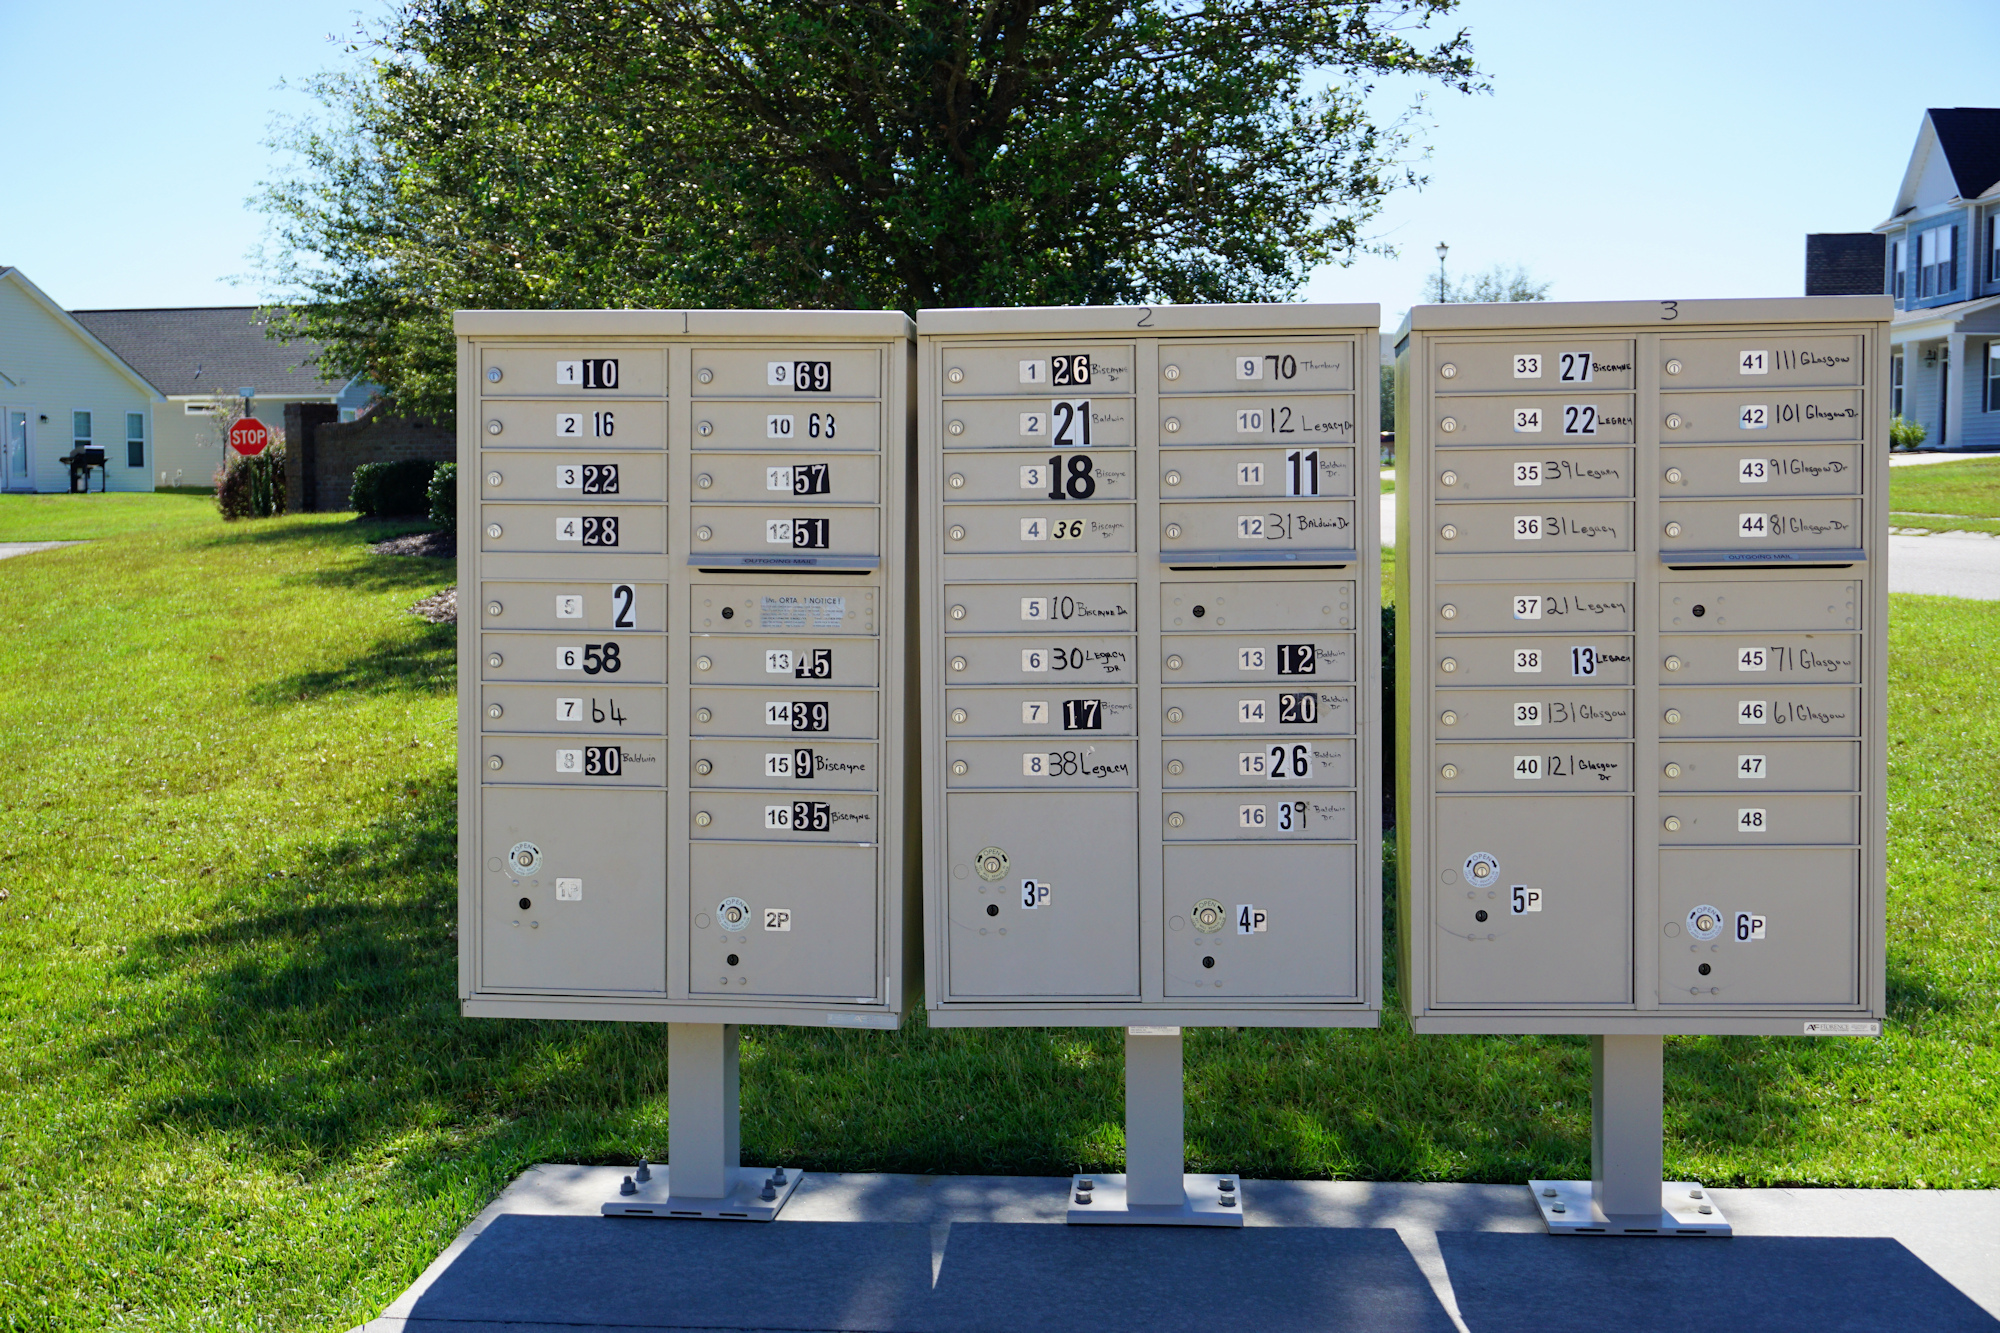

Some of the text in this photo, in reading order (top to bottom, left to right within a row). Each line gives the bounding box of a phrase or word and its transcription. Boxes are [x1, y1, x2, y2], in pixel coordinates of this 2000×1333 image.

[1137, 308, 1154, 327] 2
[1661, 301, 1678, 320] 3
[1244, 361, 1255, 376] 9
[1265, 354, 1297, 380] 70
[1517, 359, 1538, 372] 33
[1561, 354, 1590, 380] 27
[1742, 355, 1763, 369] 41
[1776, 350, 1796, 370] 111
[566, 365, 574, 380] 1
[585, 360, 617, 387] 10
[776, 366, 786, 381] 9
[796, 362, 829, 390] 69
[1028, 364, 1035, 379] 1
[1053, 356, 1088, 384] 26
[1240, 413, 1261, 429] 10
[1271, 407, 1294, 432] 12
[1517, 413, 1538, 426] 34
[1565, 407, 1595, 433] 22
[1742, 409, 1764, 423] 42
[1777, 404, 1800, 423] 101
[1806, 405, 1845, 420] Glasgow
[565, 418, 575, 433] 2
[594, 411, 614, 437] 16
[770, 419, 790, 434] 10
[808, 413, 836, 438] 63
[1028, 417, 1038, 431] 2
[1053, 402, 1090, 445] 21
[232, 430, 265, 445] STOP
[1241, 466, 1259, 481] 11
[1288, 451, 1318, 495] 11
[1517, 466, 1538, 480] 35
[1545, 461, 1572, 479] 39
[1743, 463, 1764, 477] 43
[1770, 459, 1786, 475] 91
[1791, 459, 1831, 476] Glasgow
[565, 470, 575, 484] 3
[584, 465, 617, 493] 22
[795, 465, 826, 493] 57
[1028, 470, 1038, 484] 3
[1049, 455, 1095, 499] 18
[564, 521, 574, 537] 4
[584, 518, 617, 545] 28
[1028, 522, 1039, 537] 4
[1053, 520, 1083, 538] 36
[1241, 519, 1262, 535] 12
[1267, 513, 1292, 539] 31
[1517, 520, 1538, 534] 36
[1546, 517, 1616, 538] 31 Legacy
[1742, 517, 1764, 531] 44
[1770, 515, 1785, 535] 81
[795, 520, 825, 547] 51
[615, 585, 634, 627] 2
[1029, 602, 1039, 617] 5
[1051, 596, 1074, 619] 10
[1517, 600, 1537, 613] 37
[1547, 597, 1568, 614] 21
[564, 651, 575, 666] 6
[583, 643, 621, 674] 58
[769, 654, 789, 669] 13
[796, 651, 829, 677] 45
[1030, 653, 1040, 668] 6
[1052, 648, 1083, 670] 30
[1242, 652, 1263, 666] 13
[1282, 646, 1313, 673] 12
[1517, 653, 1538, 666] 38
[1572, 648, 1594, 675] 13
[1741, 652, 1763, 665] 45
[1771, 647, 1851, 672] 71 Glasgow
[564, 702, 574, 717] 7
[769, 706, 789, 721] 14
[793, 703, 828, 729] 39
[1030, 705, 1040, 720] 7
[1067, 700, 1099, 729] 17
[1242, 705, 1263, 719] 14
[1282, 695, 1315, 722] 20
[1517, 706, 1538, 720] 39
[1548, 703, 1626, 723] 131 Glasgow
[1741, 704, 1763, 718] 46
[1774, 702, 1845, 724] 61 Glasgow
[586, 748, 619, 774] 30
[769, 758, 789, 772] 15
[797, 750, 811, 776] 9
[1031, 757, 1041, 772] 8
[1049, 751, 1077, 776] 38
[1243, 757, 1263, 771] 15
[1271, 745, 1308, 777] 26
[1517, 760, 1537, 773] 40
[1548, 755, 1574, 776] 121
[1741, 759, 1762, 773] 47
[768, 810, 788, 825] 16
[794, 803, 828, 830] 35
[1243, 810, 1263, 823] 16
[1280, 802, 1307, 829] 39
[1741, 812, 1762, 826] 48
[1024, 881, 1049, 906] 3P
[1513, 887, 1539, 913] 5P
[726, 899, 744, 907] OPEN
[1697, 907, 1716, 915] OPEN
[766, 912, 789, 927] 2P
[1240, 906, 1265, 932] 4P
[1738, 914, 1762, 940] 6P
